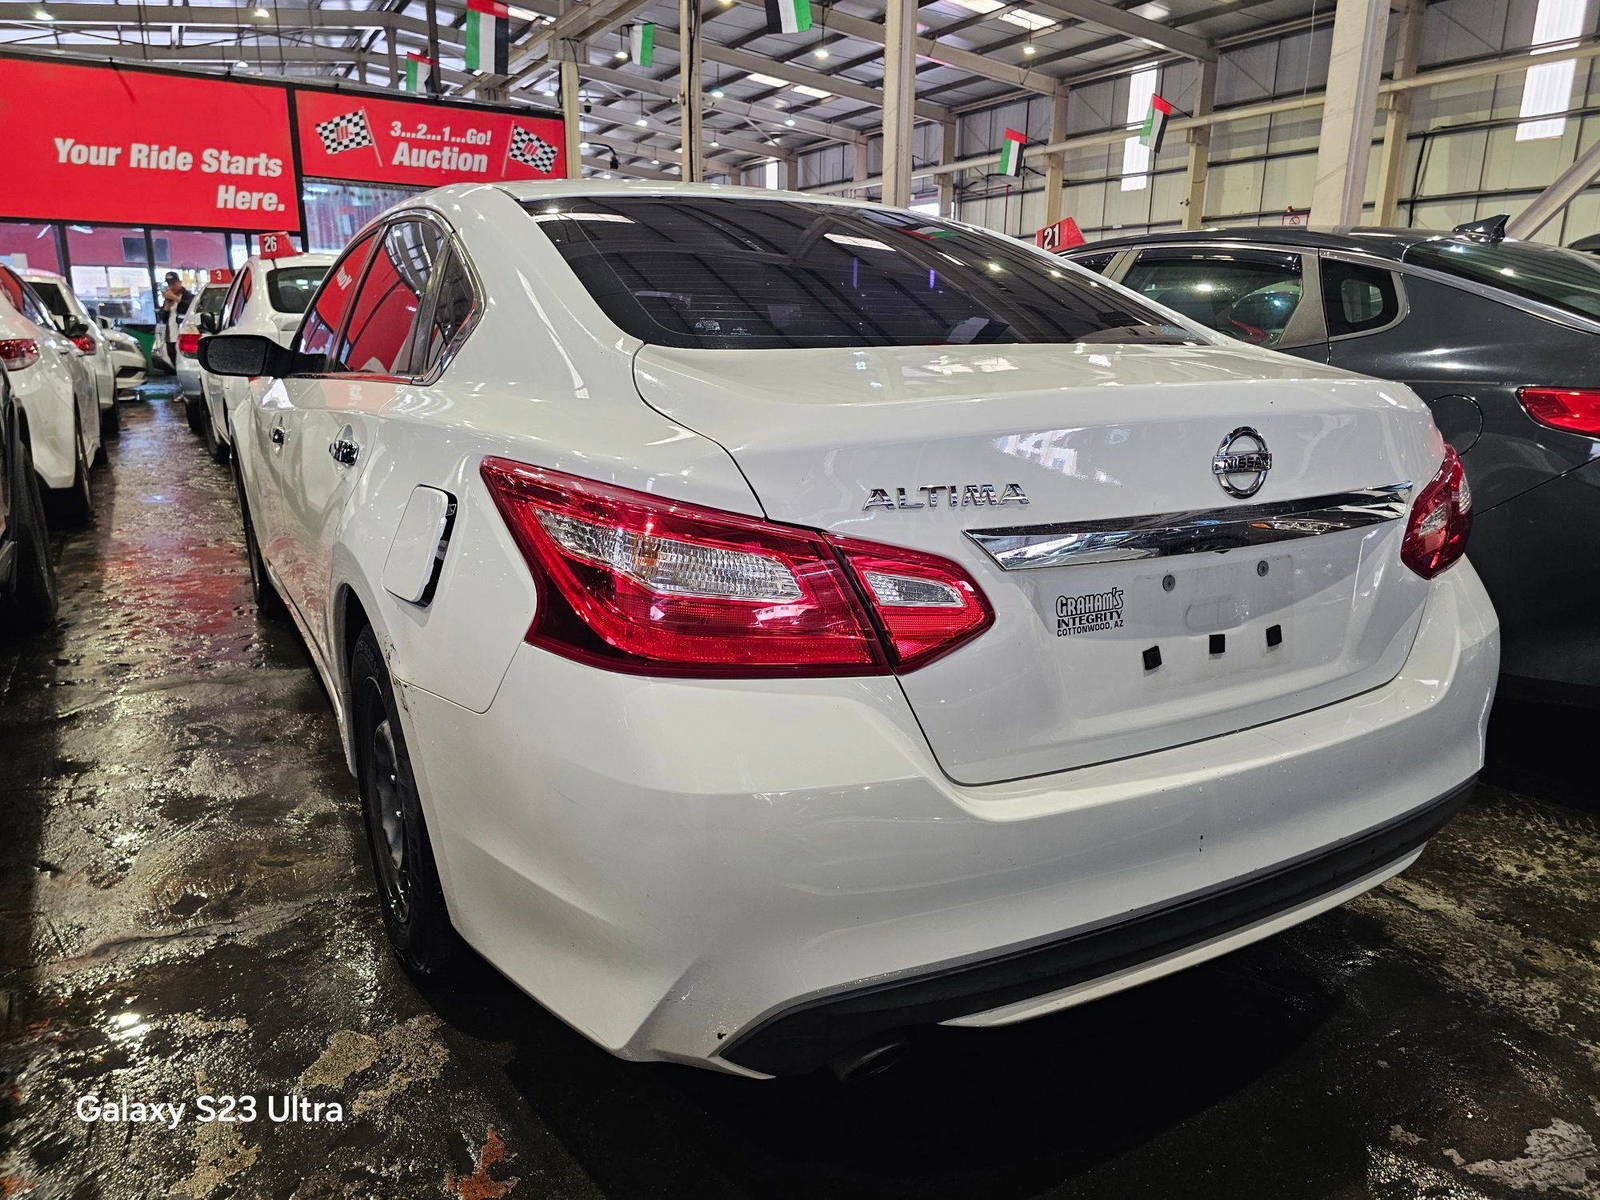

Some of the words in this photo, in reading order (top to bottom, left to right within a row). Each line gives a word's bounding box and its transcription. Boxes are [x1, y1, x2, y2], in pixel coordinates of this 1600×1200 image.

[54, 137, 122, 167] Your
[129, 143, 193, 171] Ride
[201, 148, 283, 177] Starts
[391, 142, 489, 173] Auction
[216, 184, 286, 212] Here.
[264, 236, 277, 252] 26
[1043, 223, 1060, 250] 21
[1224, 453, 1270, 470] NISSAN
[862, 483, 1030, 511] ALTIMA
[1056, 622, 1113, 637] COTTONWOOD,
[1113, 619, 1124, 629] AZ
[1057, 609, 1123, 629] INTEGRITY
